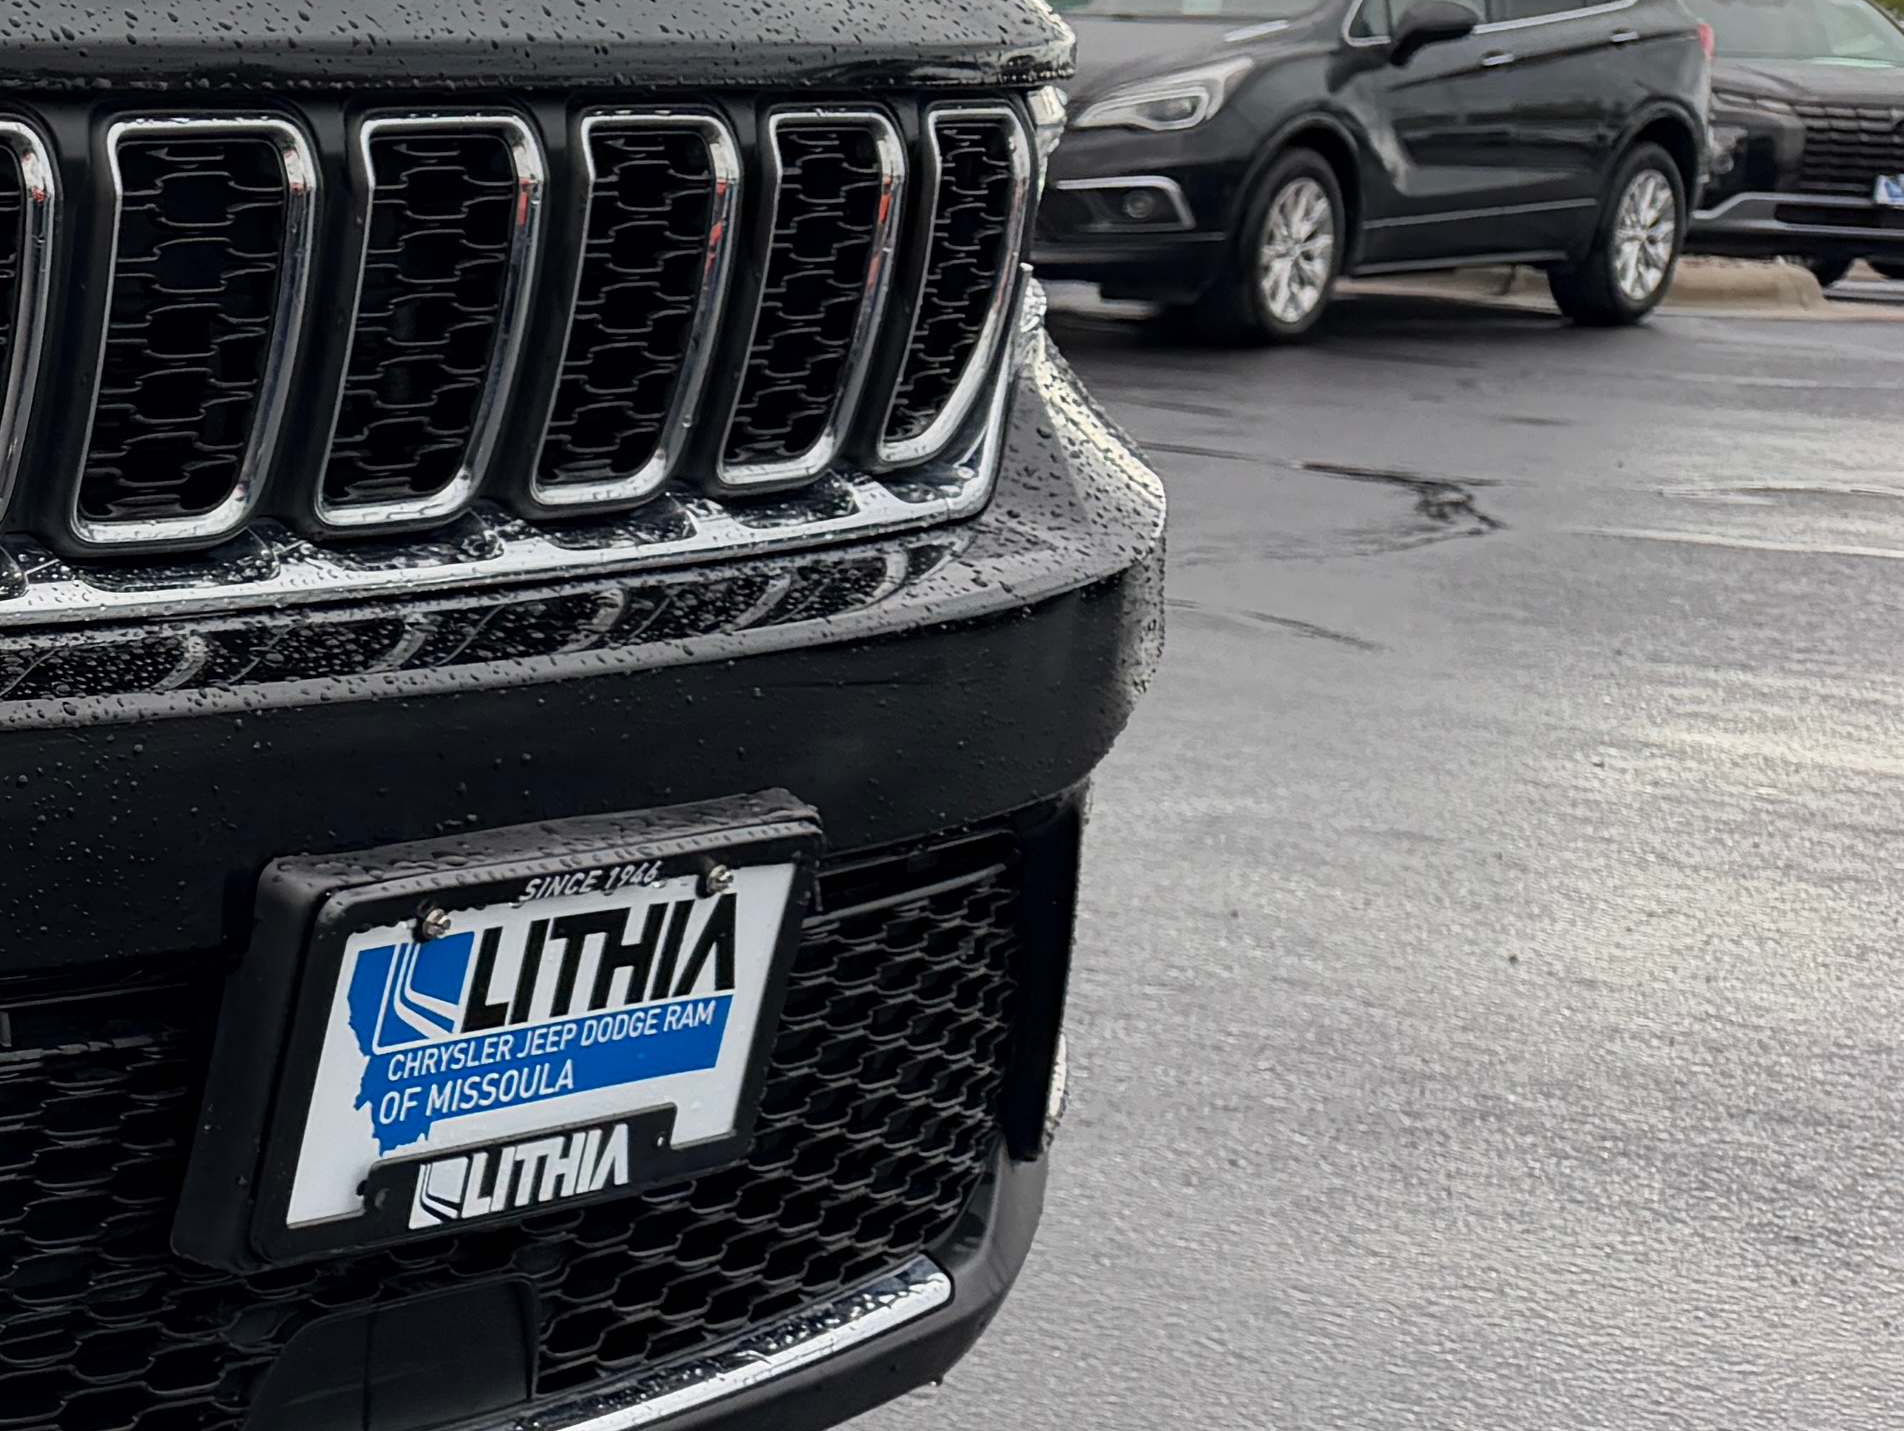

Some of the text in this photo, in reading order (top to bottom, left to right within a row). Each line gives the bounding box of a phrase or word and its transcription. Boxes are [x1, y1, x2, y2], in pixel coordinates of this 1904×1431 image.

[518, 869, 602, 902] SINCE
[460, 892, 738, 1035] LITHIA
[387, 999, 717, 1081] CHRYSLER JEEP DODGE RAM
[379, 1059, 576, 1125] OF MISSOULA
[458, 1123, 629, 1220] LITHIA
